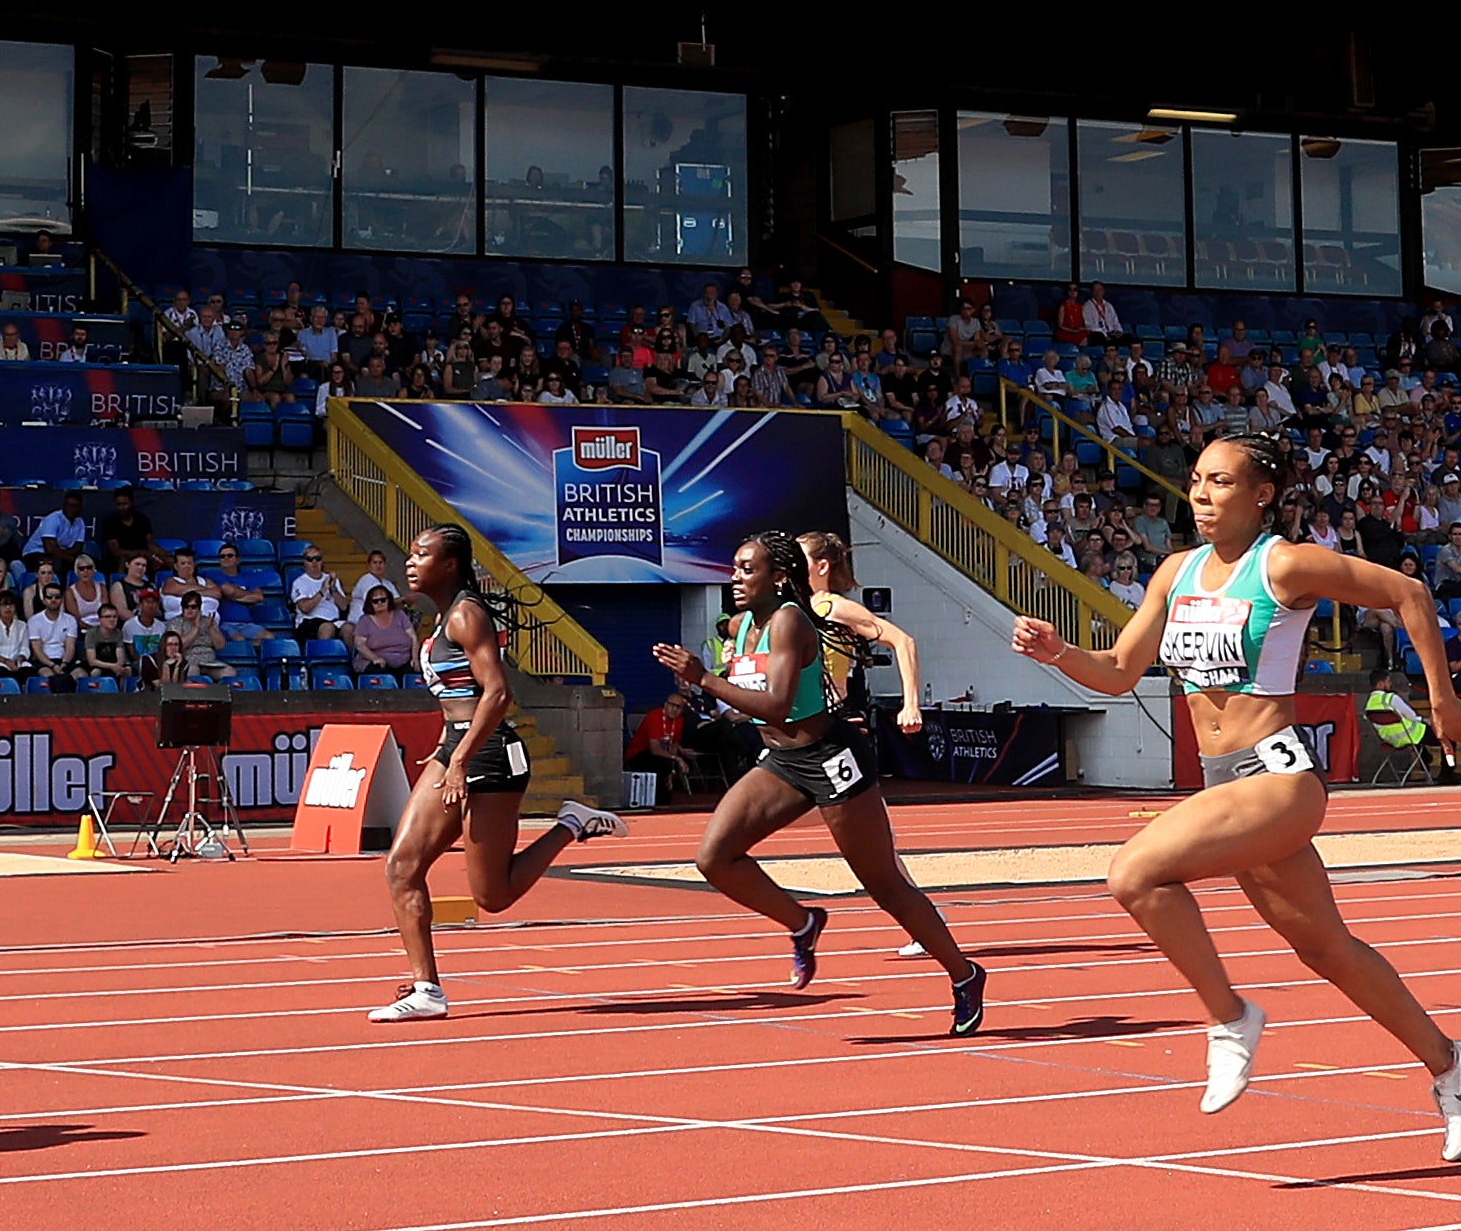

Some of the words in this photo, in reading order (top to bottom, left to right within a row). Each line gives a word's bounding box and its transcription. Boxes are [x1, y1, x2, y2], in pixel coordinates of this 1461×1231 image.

[580, 435, 633, 459] müller
[137, 451, 238, 473] BRITISH
[564, 483, 653, 503] BRITISH
[562, 507, 656, 522] ATHLETICS
[566, 527, 653, 542] CHAMPIONSHIPS
[1164, 631, 1241, 662] SKERVIN
[949, 728, 998, 744] BRITISH
[952, 746, 998, 759] ATHLETICS
[1270, 741, 1297, 768] 3
[837, 757, 853, 782] 6
